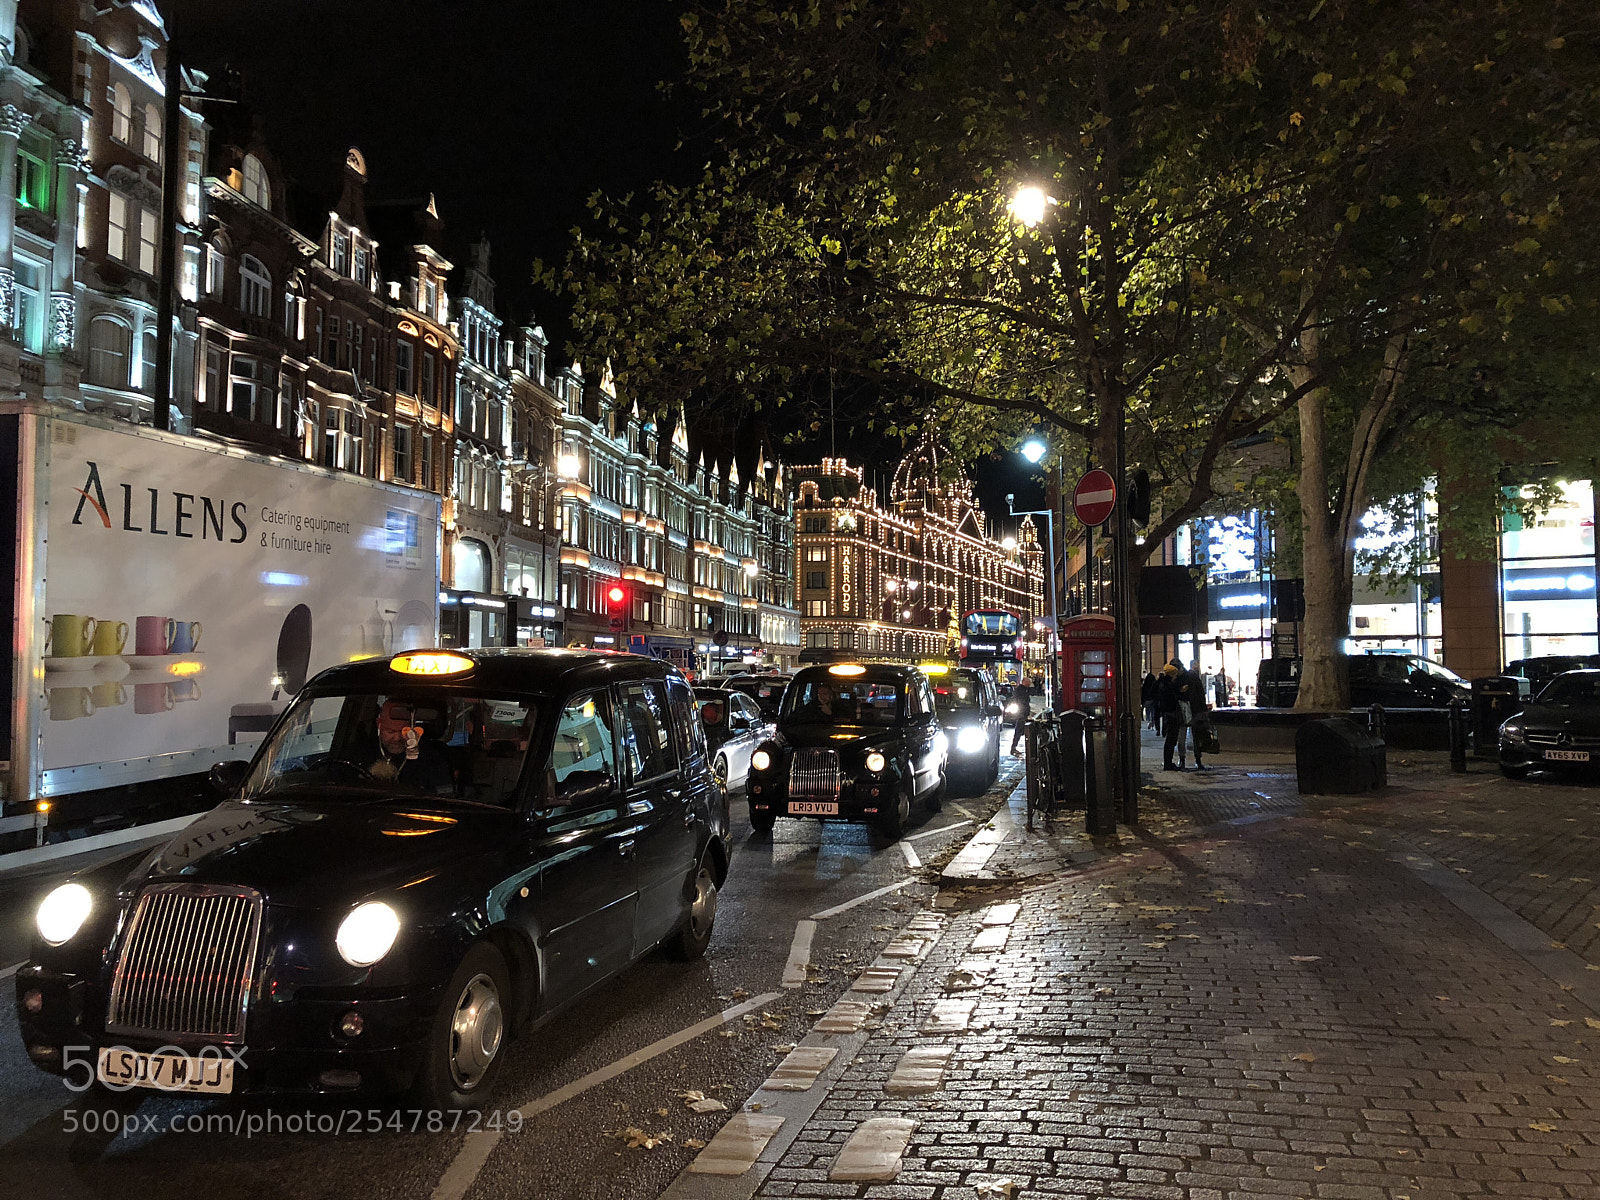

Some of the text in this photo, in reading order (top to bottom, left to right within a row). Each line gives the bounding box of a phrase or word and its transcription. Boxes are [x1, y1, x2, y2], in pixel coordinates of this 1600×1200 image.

[72, 461, 248, 544] ALLENS
[261, 507, 350, 535] Catering equipment
[260, 532, 332, 555] & furniture hire
[842, 545, 851, 612] HARRODS
[1001, 643, 1013, 653] 74
[405, 657, 452, 673] TAXI
[1547, 751, 1569, 760] AY65
[792, 802, 833, 813] LR13 VVU
